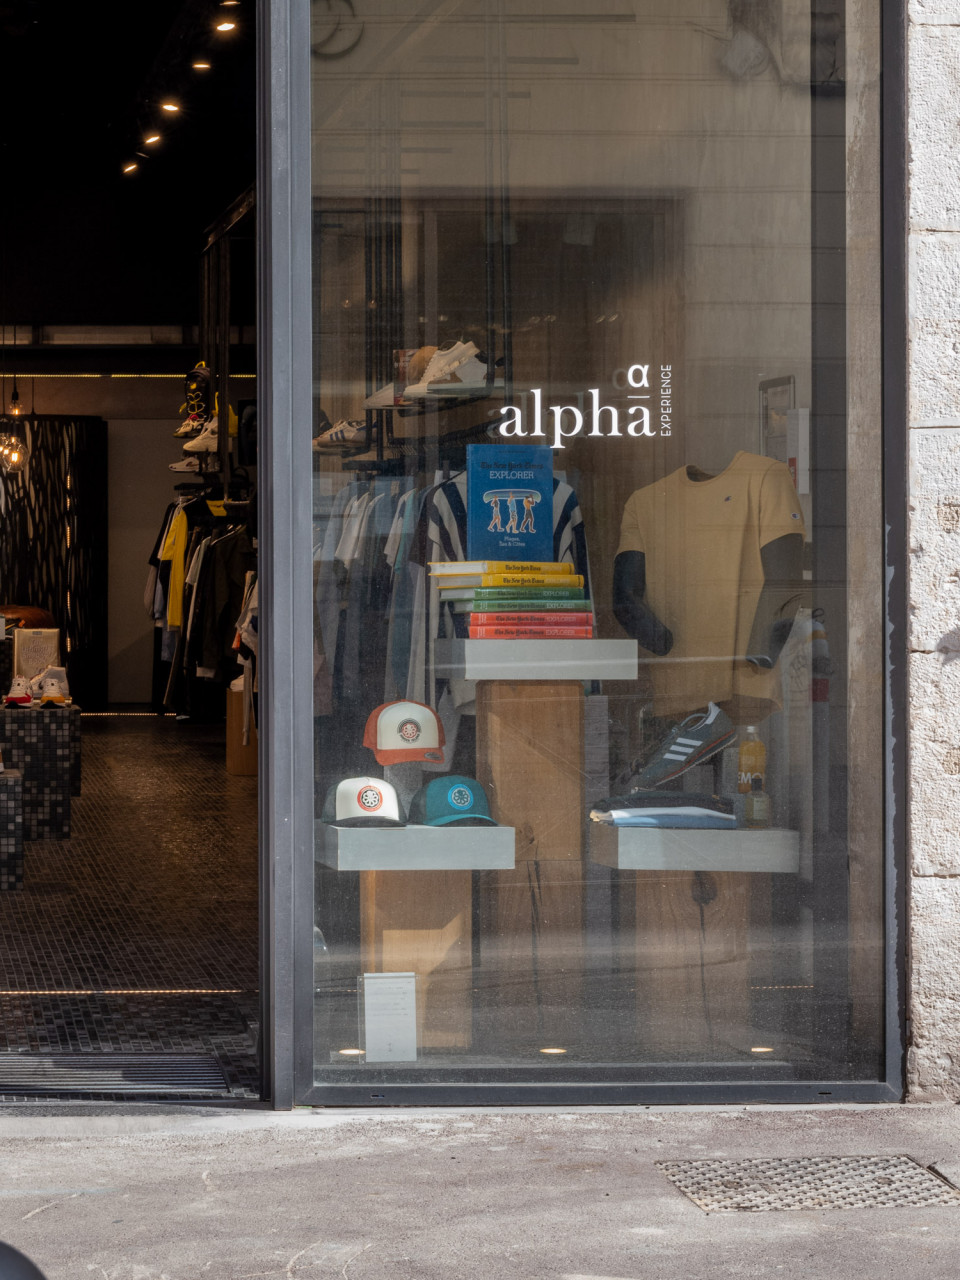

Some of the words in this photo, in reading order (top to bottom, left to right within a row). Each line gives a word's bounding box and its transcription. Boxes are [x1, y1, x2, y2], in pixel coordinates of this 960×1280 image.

[499, 389, 656, 449] alpha
[660, 364, 672, 437] EXPERIENCE
[489, 470, 535, 479] EXPLORER
